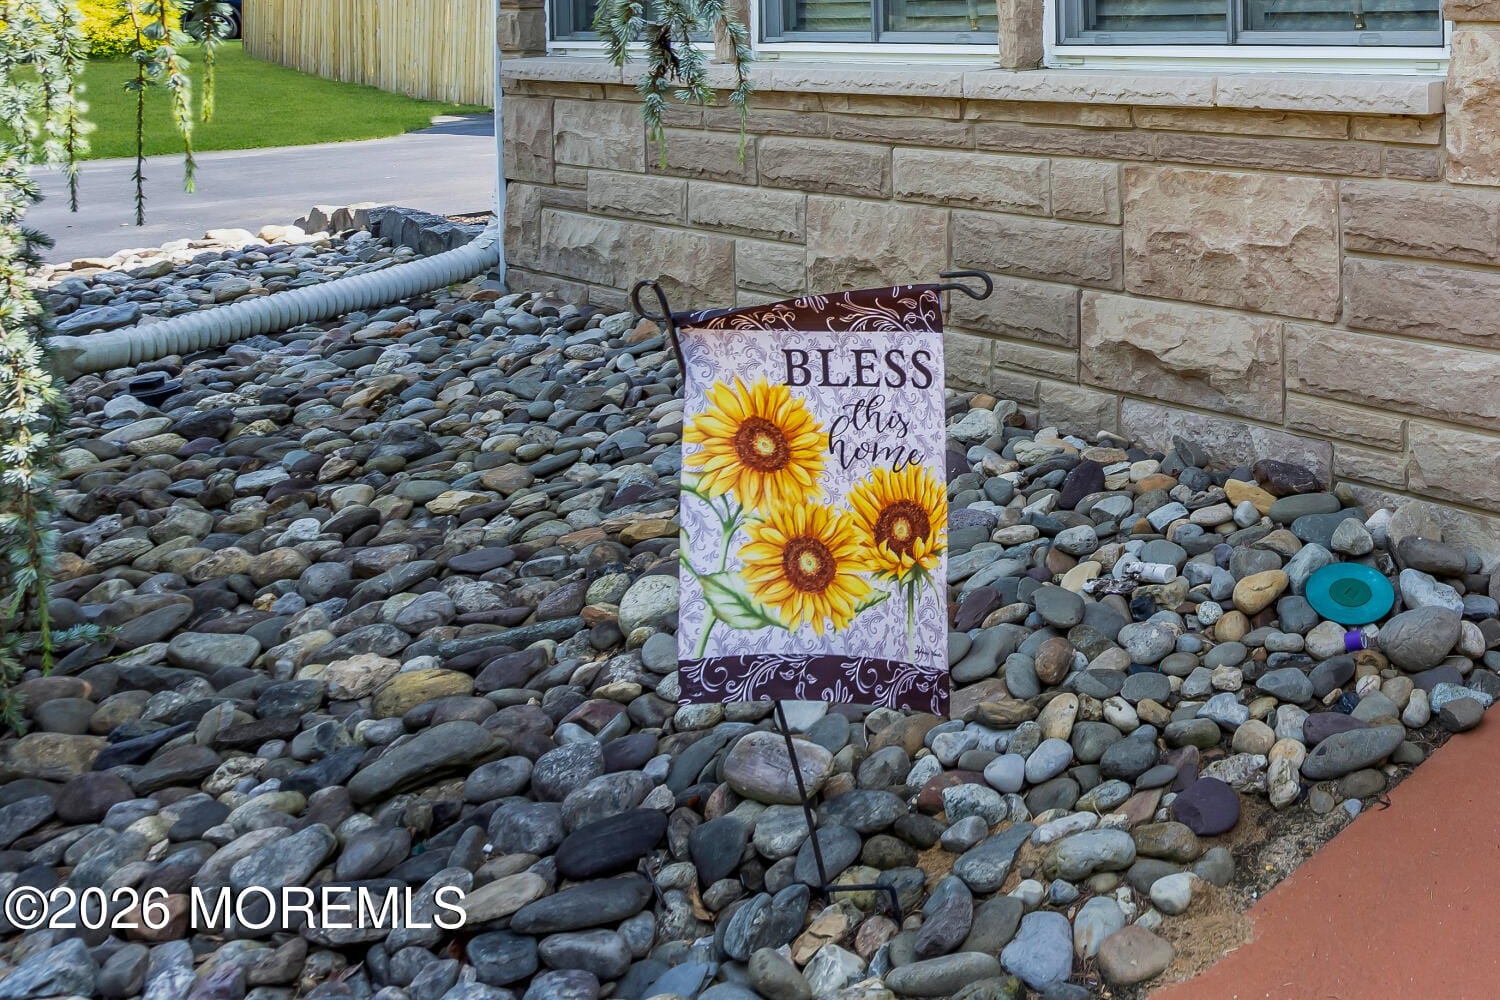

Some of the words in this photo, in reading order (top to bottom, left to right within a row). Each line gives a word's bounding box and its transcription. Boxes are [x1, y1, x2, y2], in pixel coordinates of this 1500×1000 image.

[782, 348, 933, 389] BLESS
[842, 394, 909, 438] this
[828, 414, 925, 473] home
